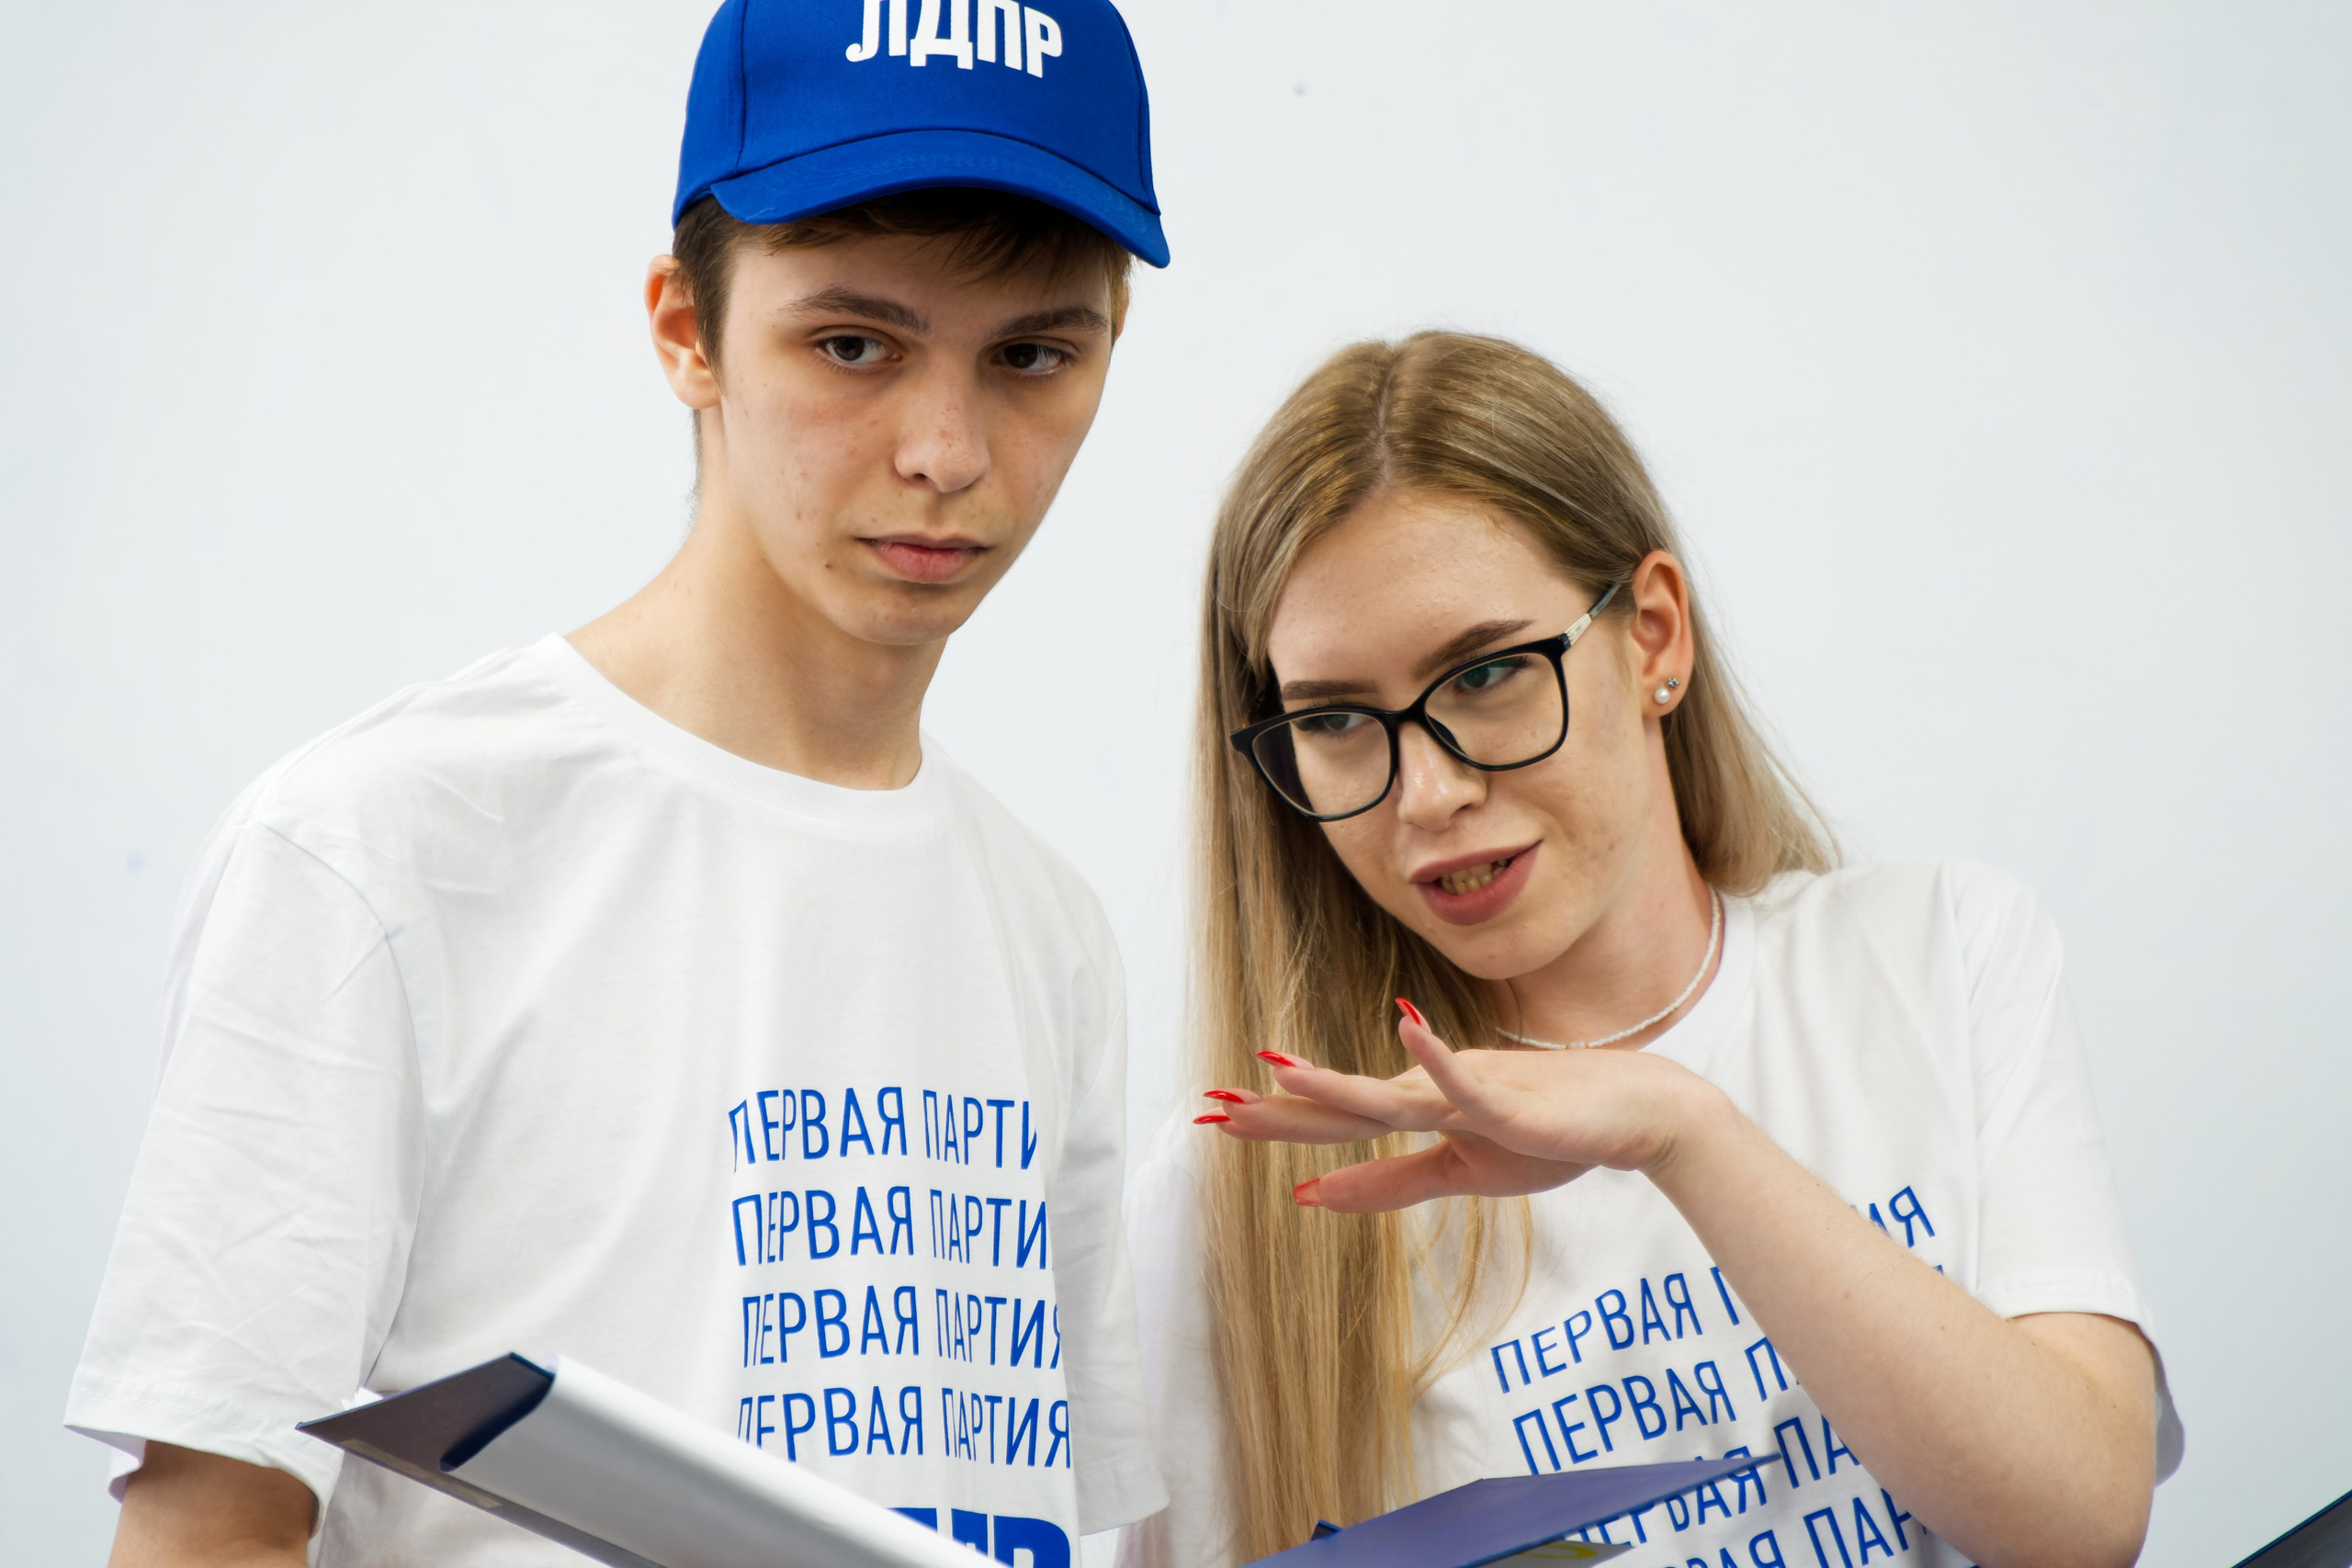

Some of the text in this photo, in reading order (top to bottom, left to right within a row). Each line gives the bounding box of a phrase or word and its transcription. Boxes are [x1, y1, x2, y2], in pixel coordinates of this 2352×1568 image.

[845, 0, 1063, 79] ЛДПР
[729, 1086, 909, 1174] ПЕРВАЯ
[731, 1185, 1048, 1270] ПЕРВАЯ ПАРТИ
[741, 1285, 920, 1369] ПЕРВАЯ
[1490, 1271, 1703, 1394] ПЕРВАЯ
[738, 1385, 1071, 1470] ПЕРВАЯ ПАРТИЯ
[1511, 1359, 1737, 1477] ПЕРВАЯ
